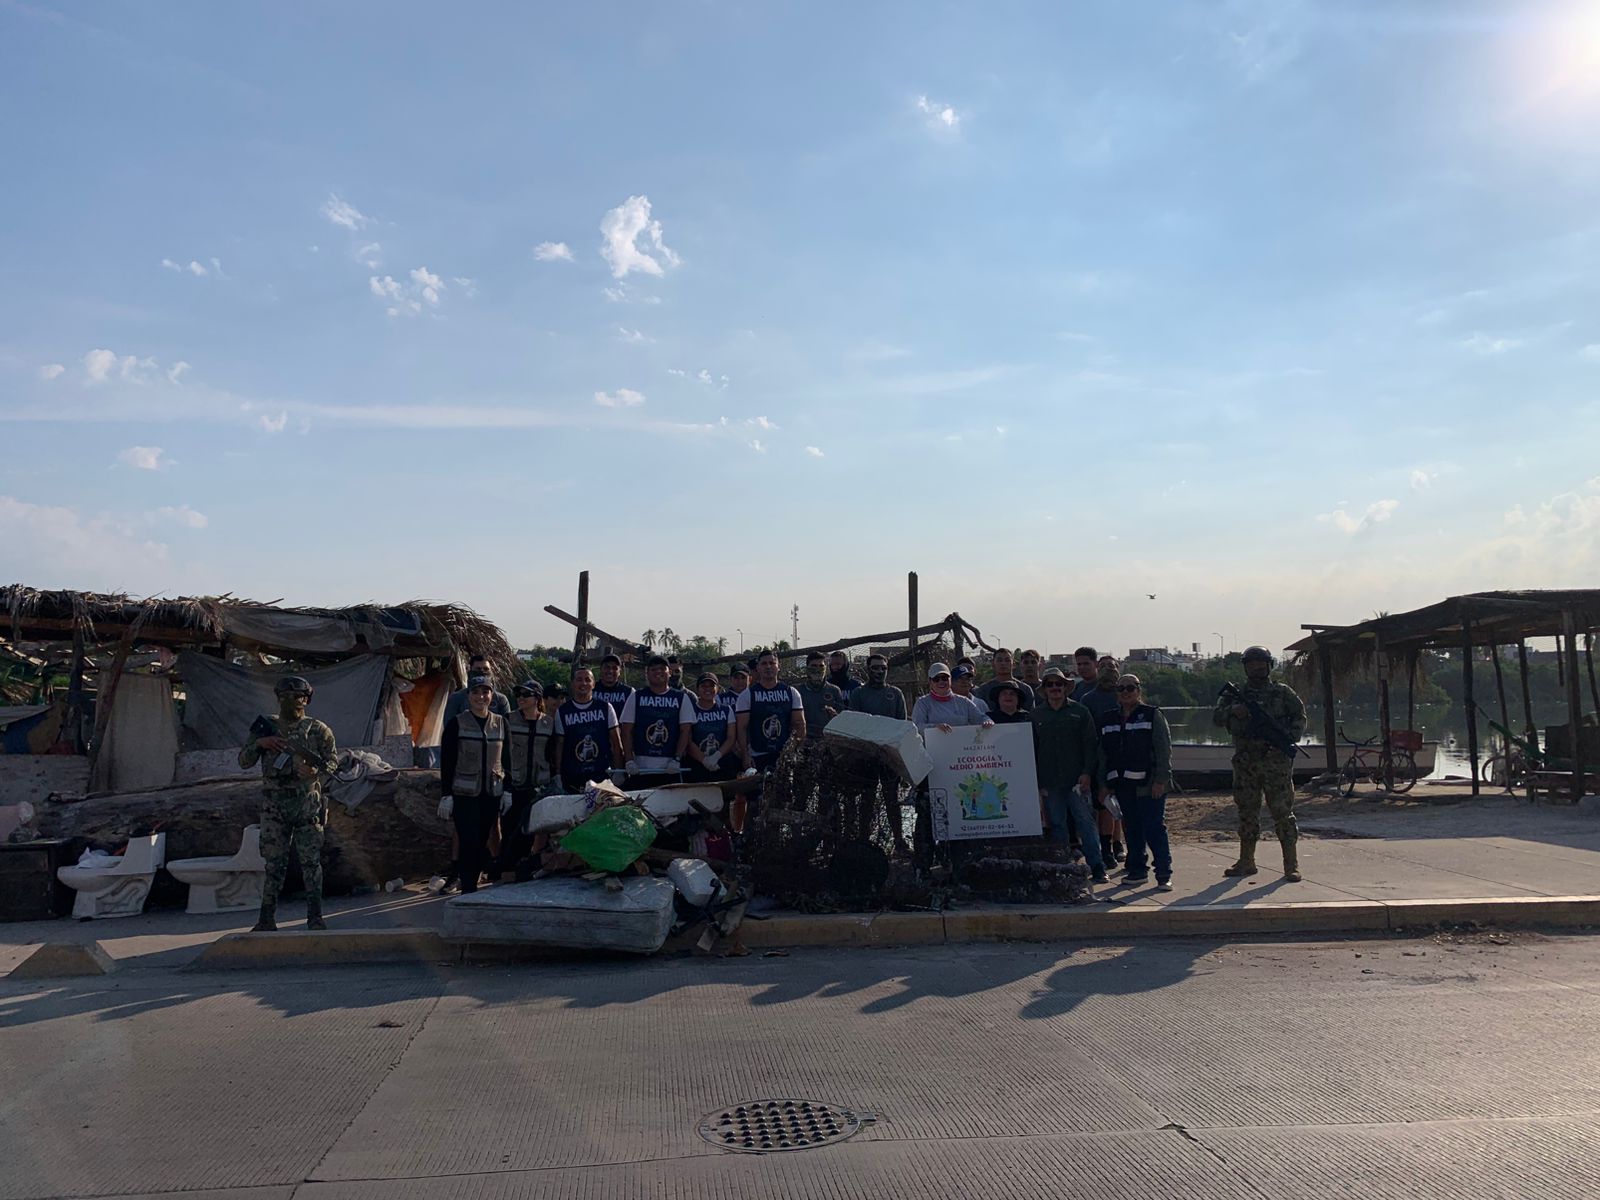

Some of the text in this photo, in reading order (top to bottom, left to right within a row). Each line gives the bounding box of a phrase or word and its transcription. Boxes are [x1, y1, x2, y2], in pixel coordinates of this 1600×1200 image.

[639, 696, 680, 708] MARINA
[754, 690, 790, 702] MARINA
[564, 709, 605, 726] MARINA
[696, 710, 727, 722] ARINA
[975, 761, 1012, 769] AMBIENTE
